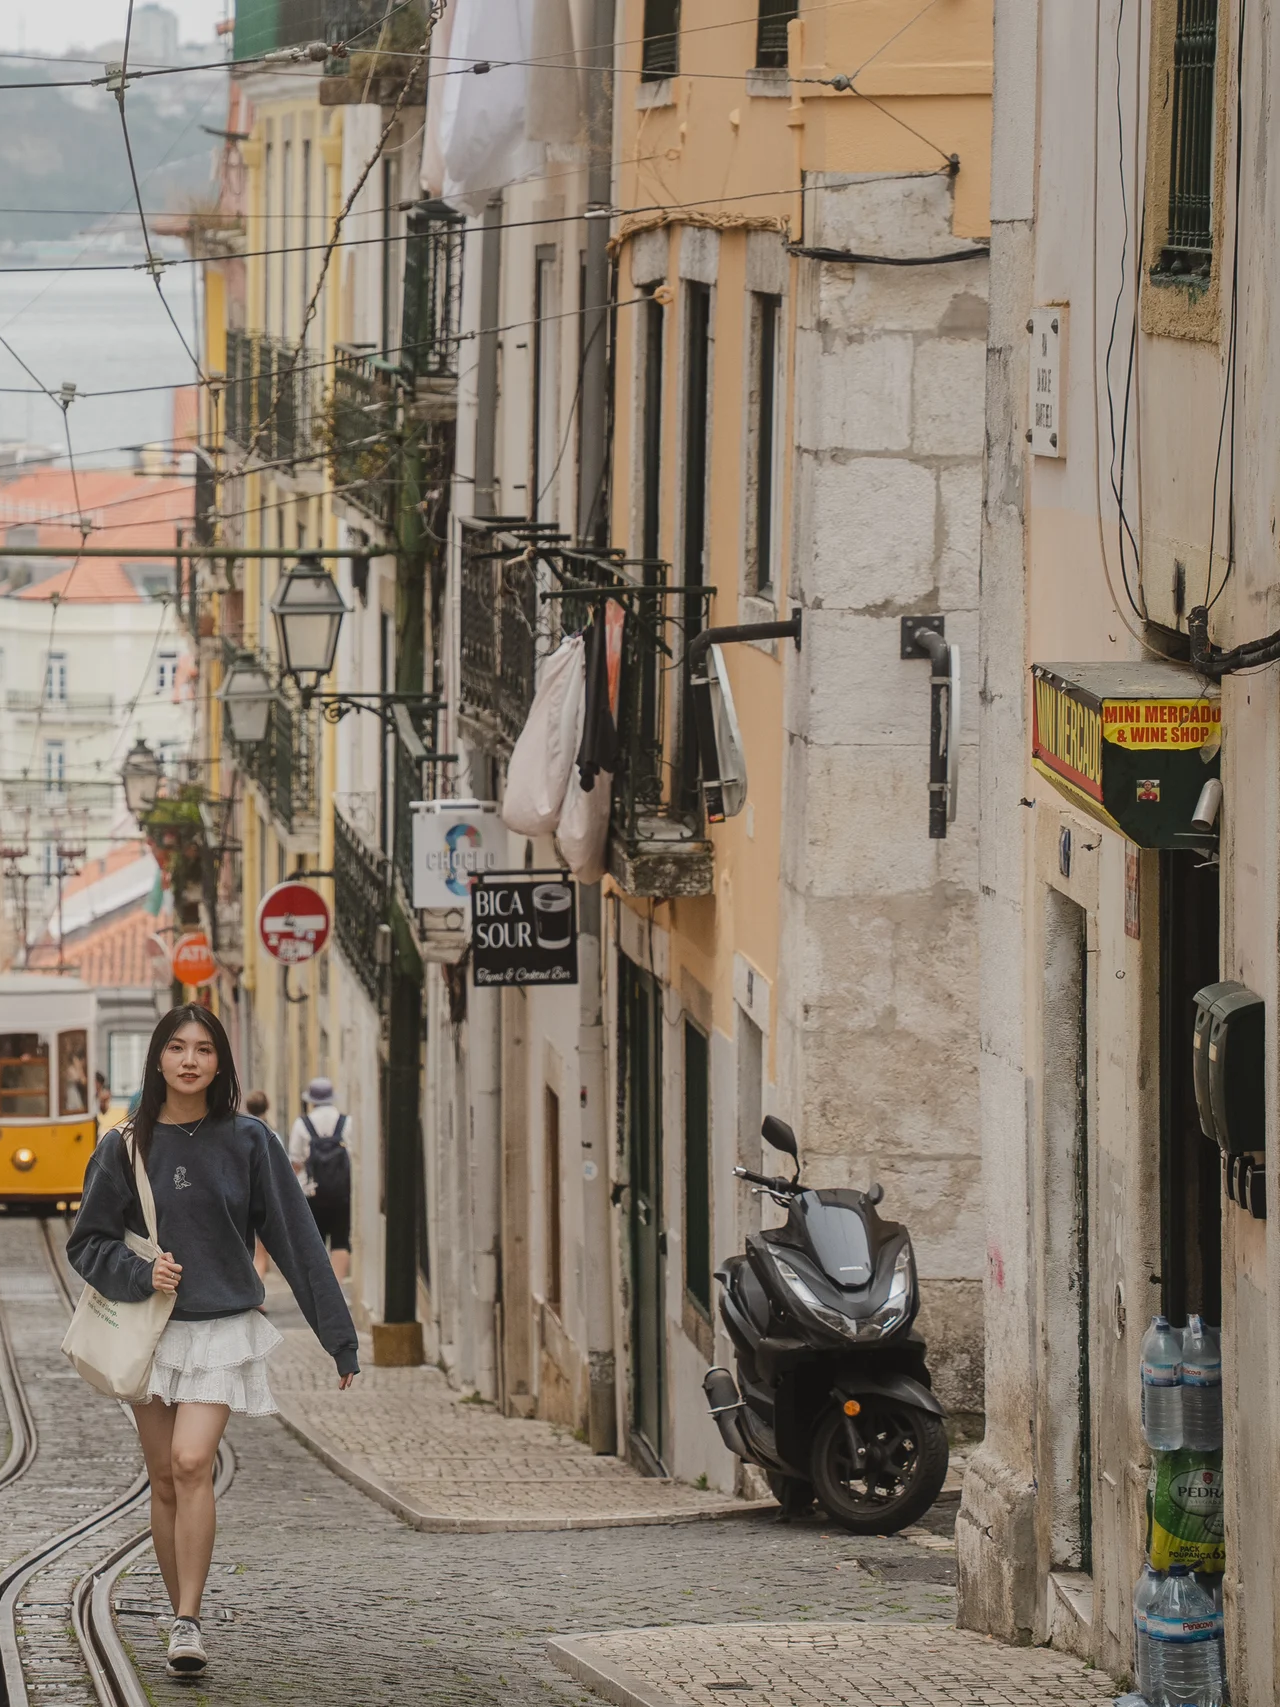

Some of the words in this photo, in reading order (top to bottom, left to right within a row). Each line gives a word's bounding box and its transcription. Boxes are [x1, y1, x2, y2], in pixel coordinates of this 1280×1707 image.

[1104, 705, 1141, 723] MINI
[1144, 705, 1222, 723] MERCADO
[1057, 690, 1102, 785] MERCADO
[1117, 729, 1128, 743] &
[1130, 727, 1168, 743] WINE
[1171, 727, 1209, 743] SHOP
[475, 890, 524, 917] BICA
[476, 921, 533, 949] SOUR
[1169, 1551, 1211, 1560] POUPANÇA
[1182, 1621, 1213, 1631] Penacova
